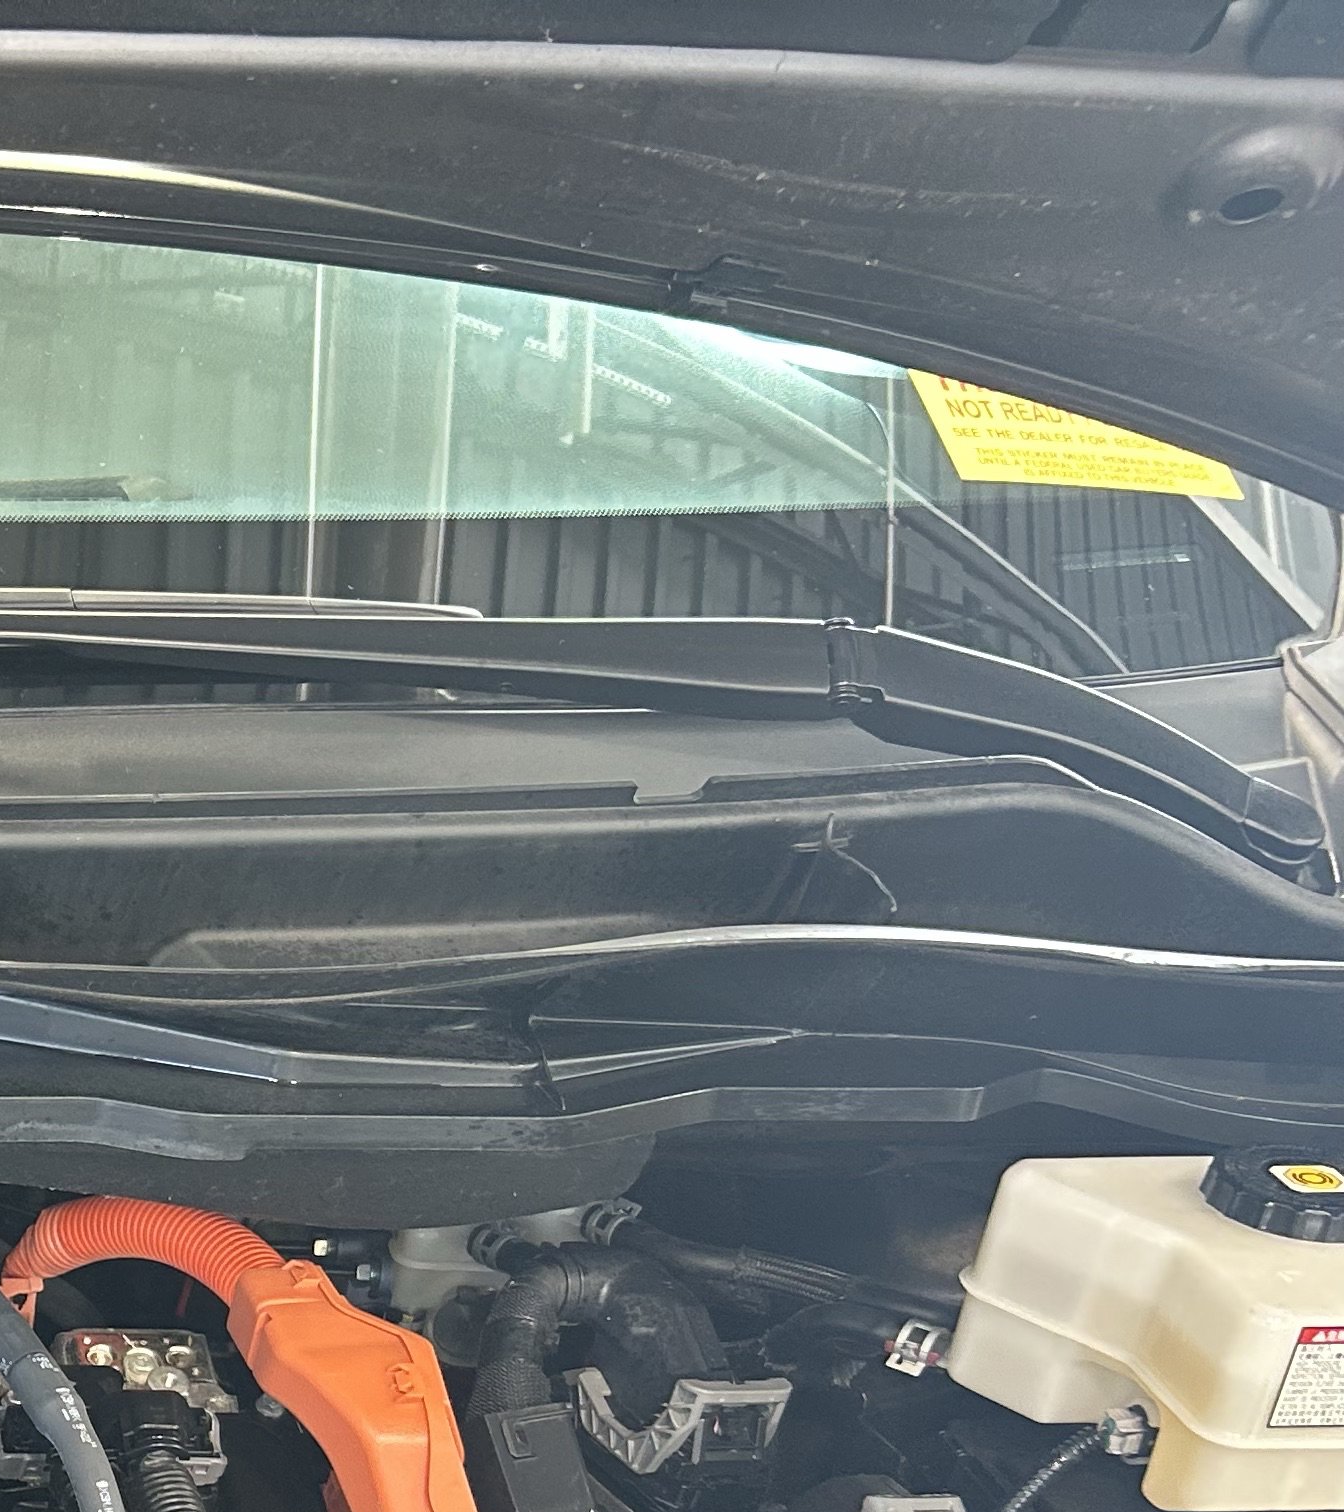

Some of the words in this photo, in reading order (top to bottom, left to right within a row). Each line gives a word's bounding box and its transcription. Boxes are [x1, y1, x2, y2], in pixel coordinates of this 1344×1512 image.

[945, 399, 994, 419] NOT
[952, 426, 980, 438] SEE
[986, 428, 1014, 439] THE
[1019, 431, 1073, 442] DEALER
[1079, 434, 1108, 446] FOR
